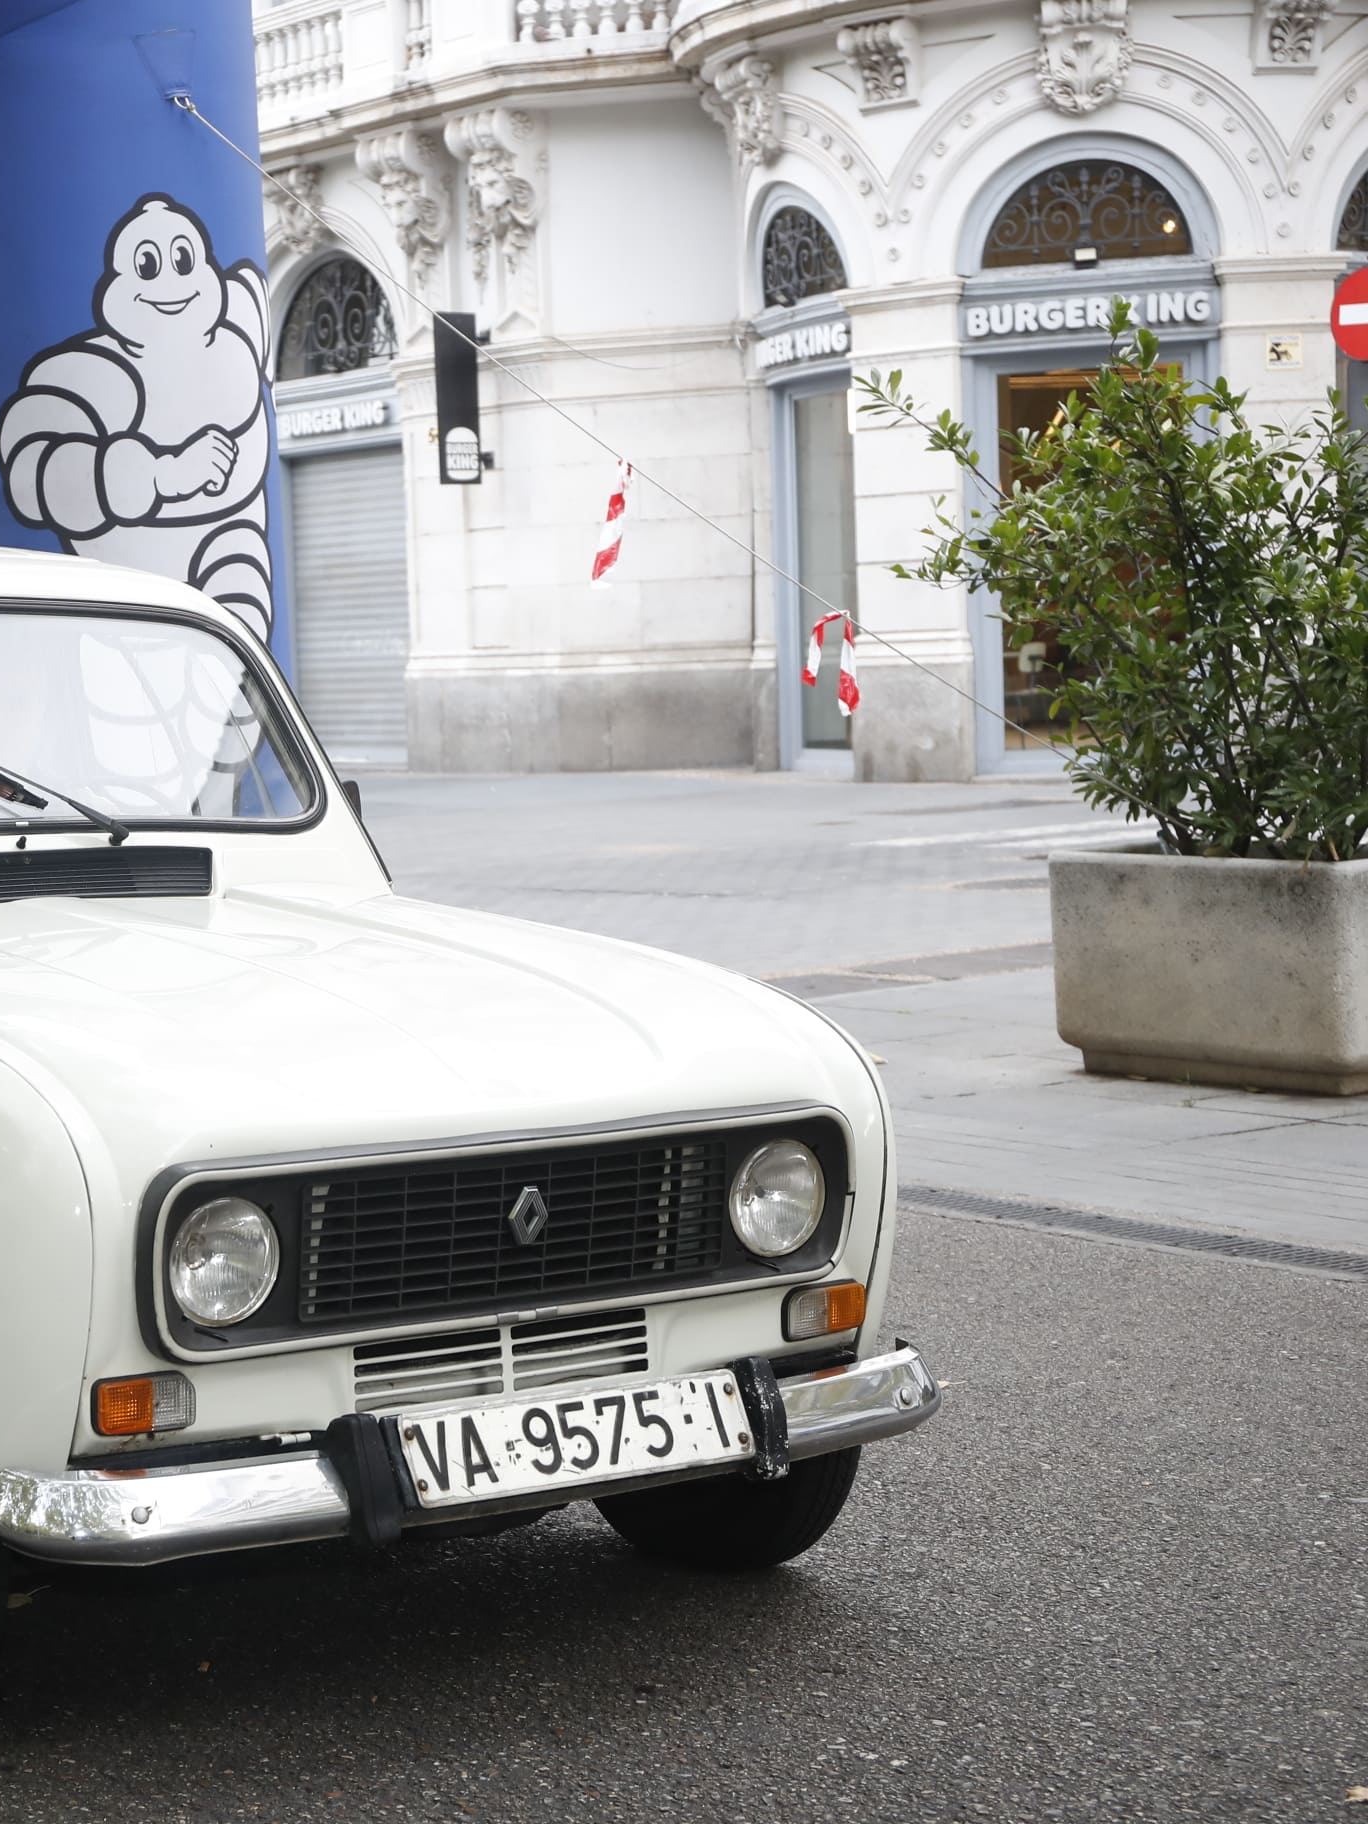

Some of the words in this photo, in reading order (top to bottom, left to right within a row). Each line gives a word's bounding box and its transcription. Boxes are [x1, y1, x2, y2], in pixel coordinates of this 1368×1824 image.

[966, 295, 1112, 338] BURGER
[794, 322, 848, 359] KING
[277, 407, 342, 438] BURGER
[343, 399, 385, 429] KING
[446, 454, 479, 469] KING
